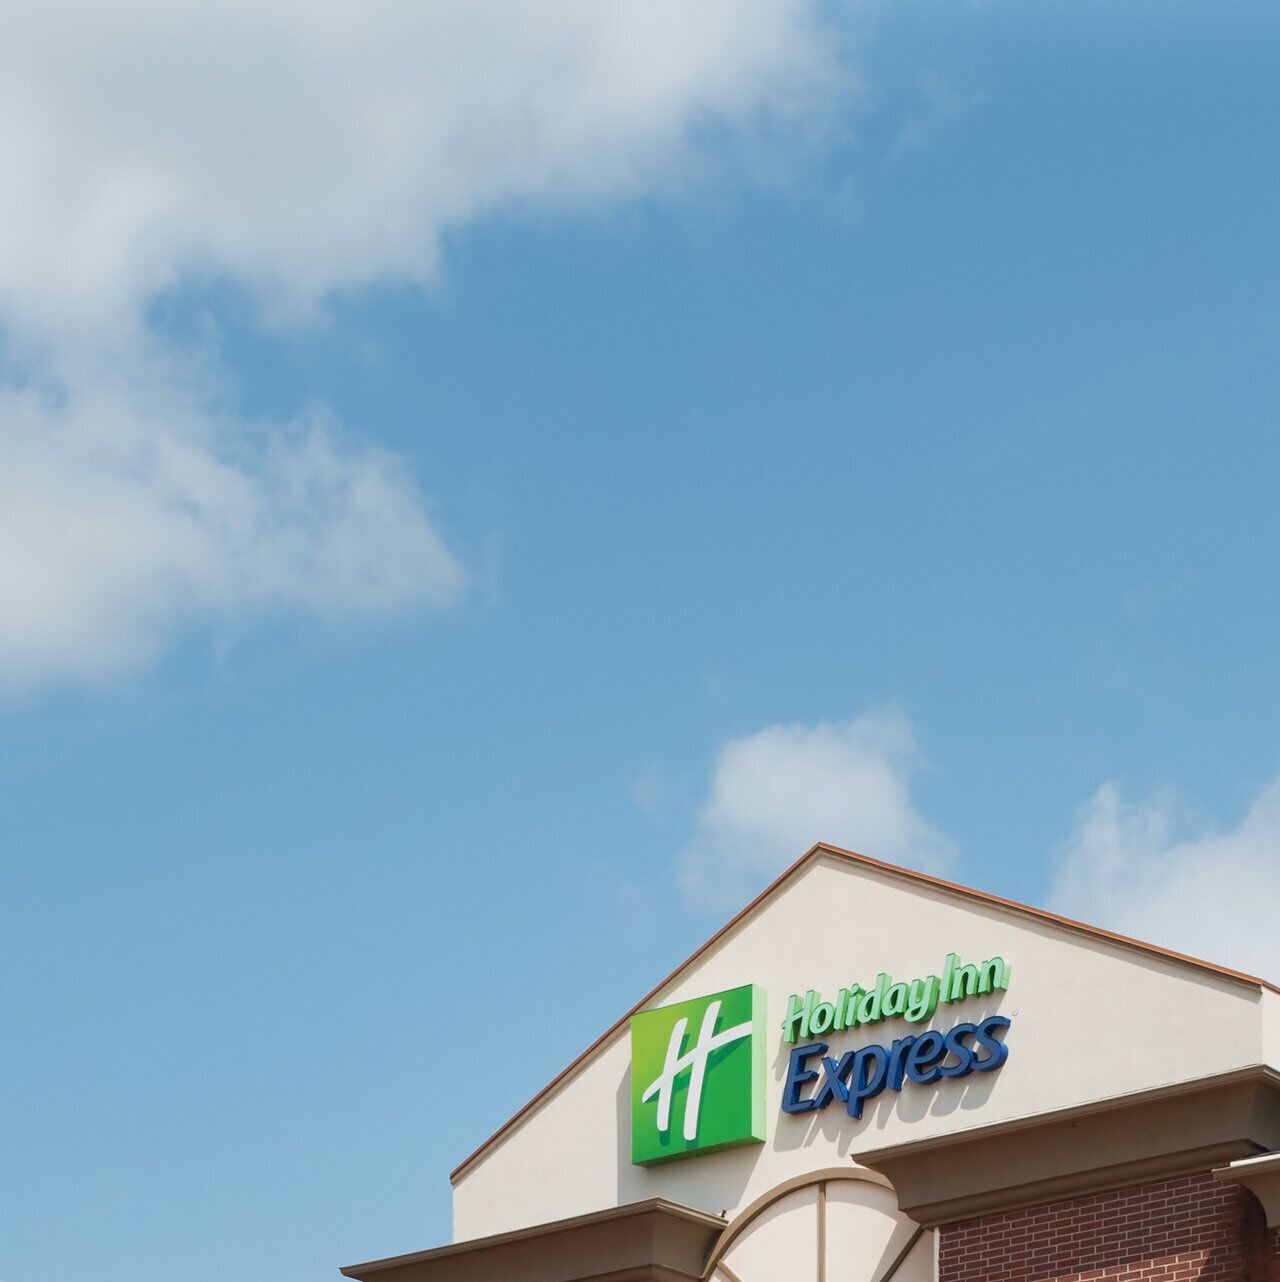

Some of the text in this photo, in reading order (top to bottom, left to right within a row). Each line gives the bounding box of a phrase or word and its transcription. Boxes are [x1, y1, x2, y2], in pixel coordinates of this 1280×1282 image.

[781, 952, 1011, 1043] Holiday Inn
[642, 1001, 753, 1140] H
[781, 1015, 1011, 1120] Express
